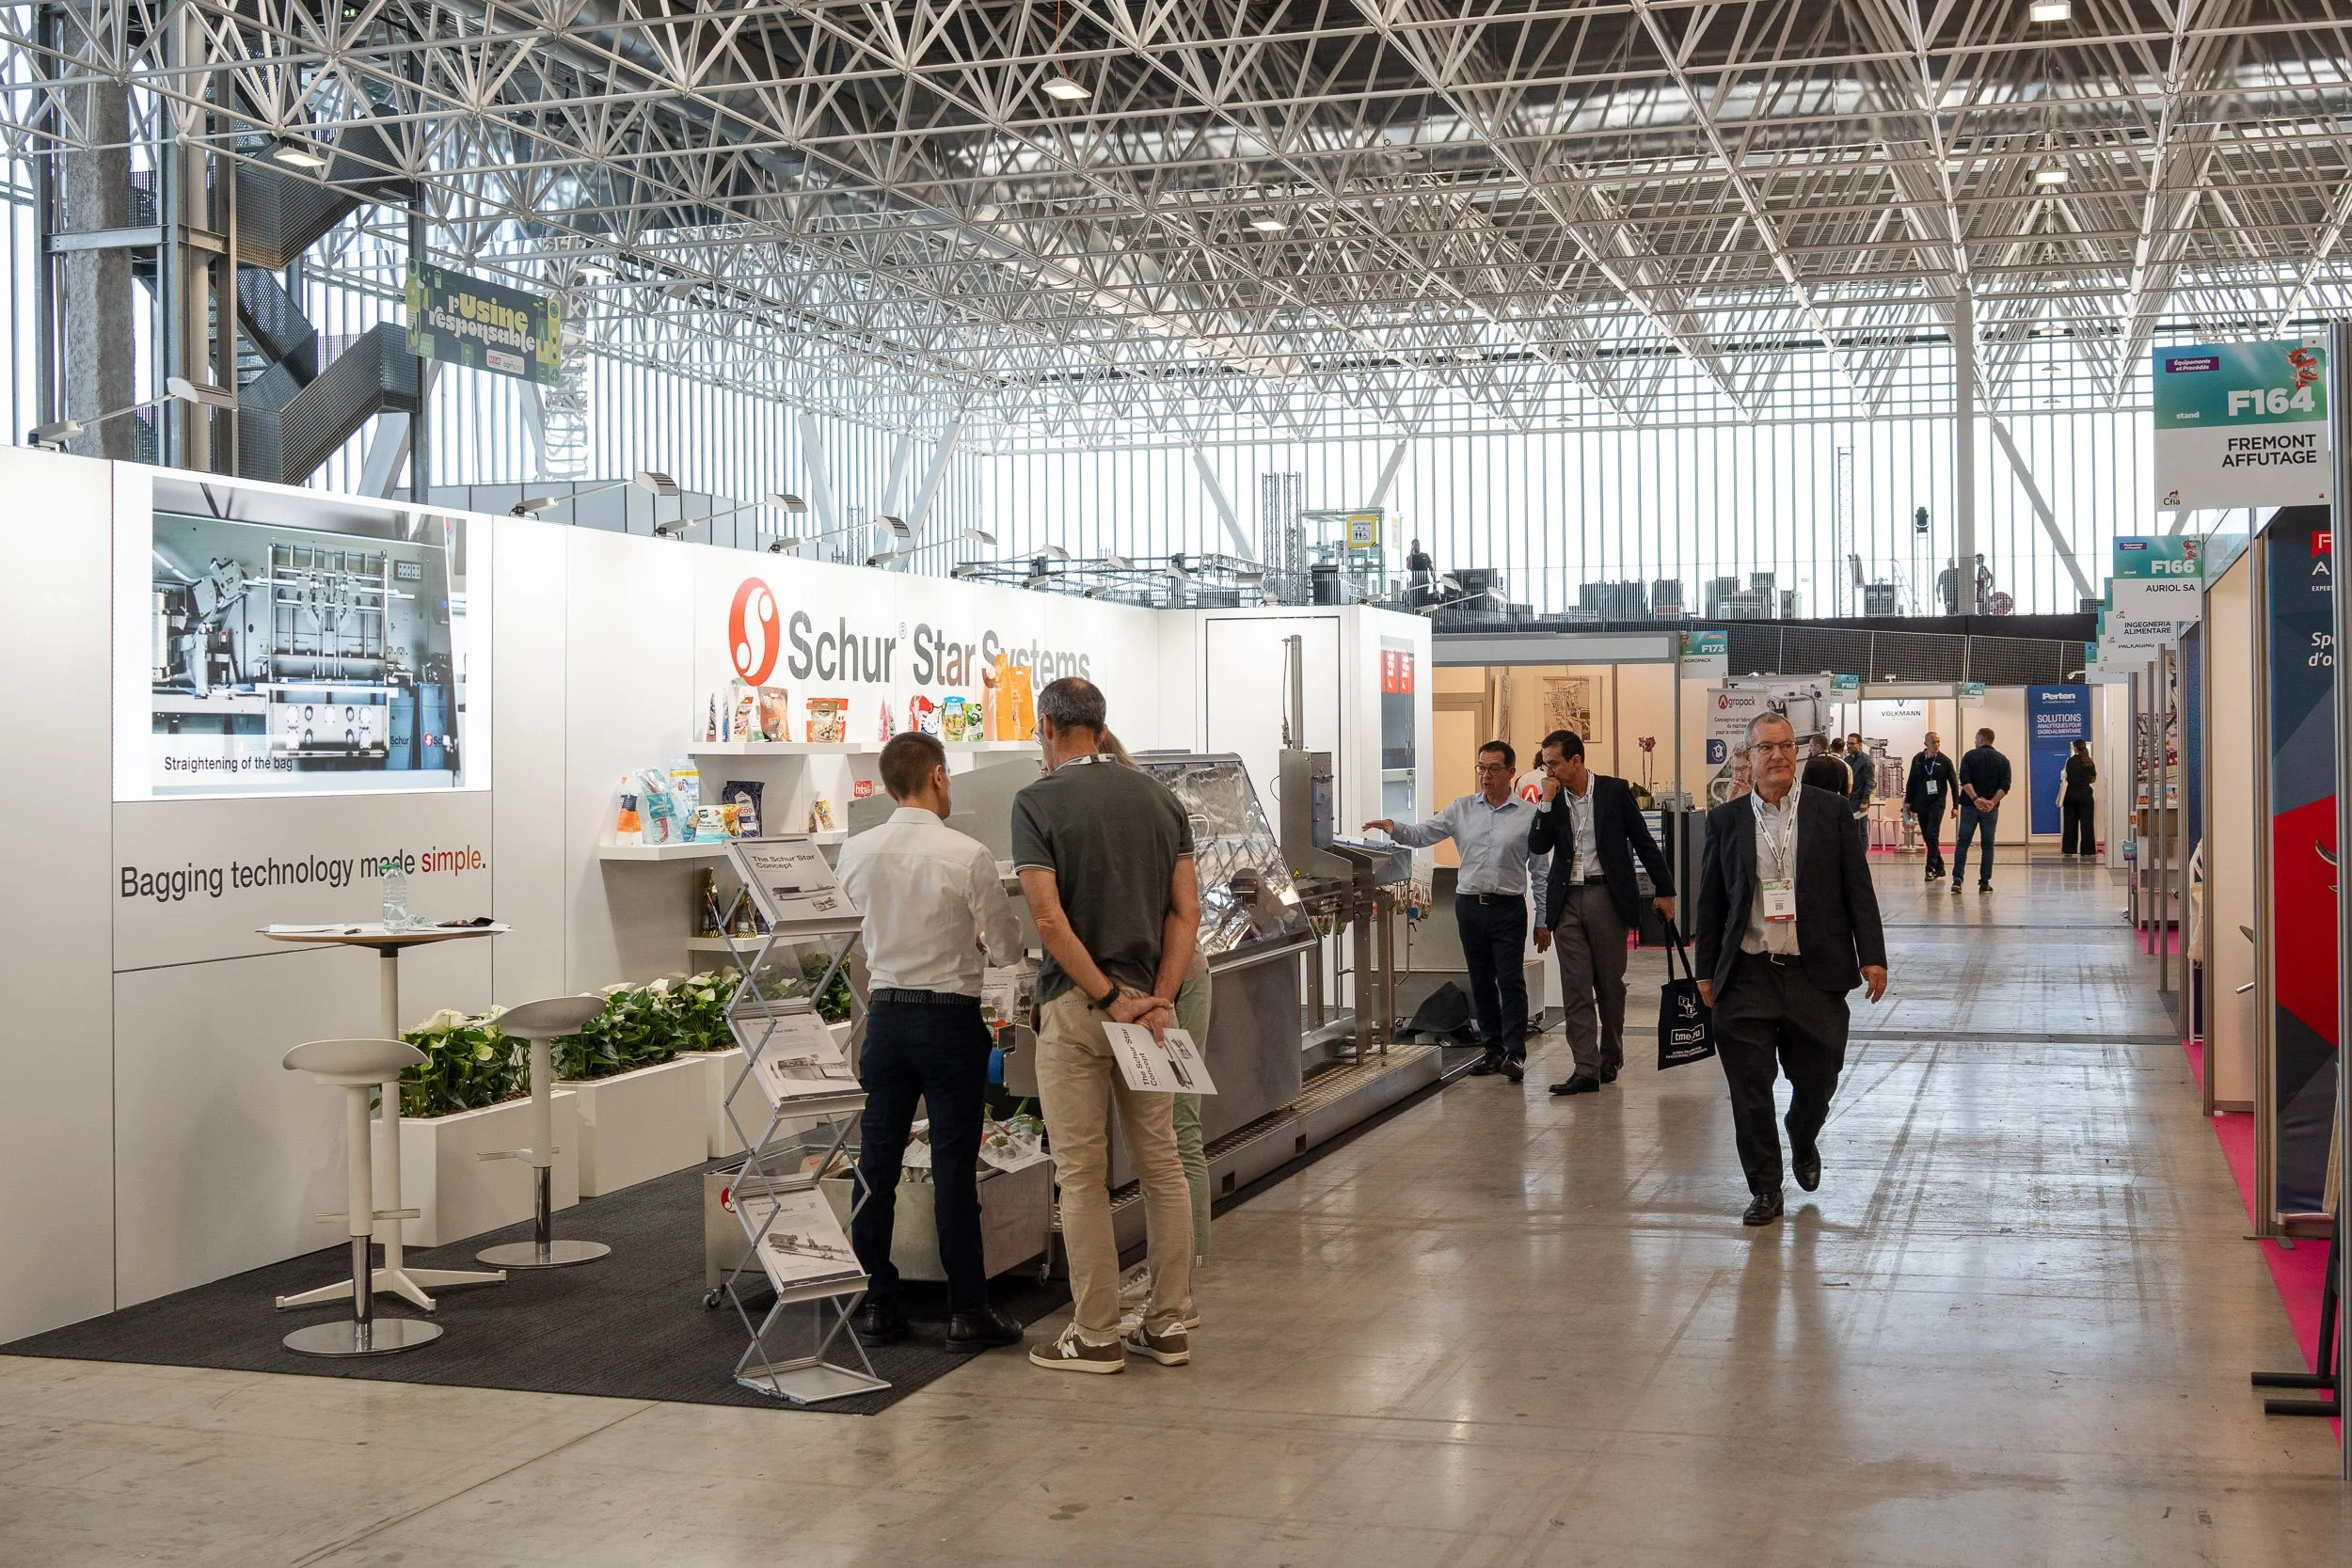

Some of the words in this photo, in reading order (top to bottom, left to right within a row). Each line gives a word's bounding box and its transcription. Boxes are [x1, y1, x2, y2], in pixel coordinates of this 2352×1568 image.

[428, 306, 536, 354] responsable
[2173, 358, 2211, 367] Équipements
[2227, 387, 2315, 417] F164
[2176, 411, 2201, 420] stand
[2228, 434, 2317, 451] FREMONT
[2221, 450, 2317, 468] AFFUTAGE
[2151, 559, 2196, 575] F166
[913, 623, 976, 687] Star
[1701, 644, 1724, 653] F173
[2042, 692, 2076, 701] Perten
[2037, 713, 2082, 723] SOLUTIONS
[389, 736, 410, 746] Schur
[164, 755, 238, 772] Straightening
[241, 755, 253, 770] of
[254, 755, 271, 769] the
[273, 756, 293, 772] bag
[120, 863, 223, 903] Bagging
[230, 854, 354, 889] technology
[360, 848, 416, 879] made
[421, 845, 487, 877] simple.
[755, 862, 793, 870] Concept
[1121, 1028, 1132, 1045] Star
[1129, 1045, 1143, 1069] Schur
[1139, 1053, 1158, 1086] Concept
[1140, 1070, 1150, 1085] The
